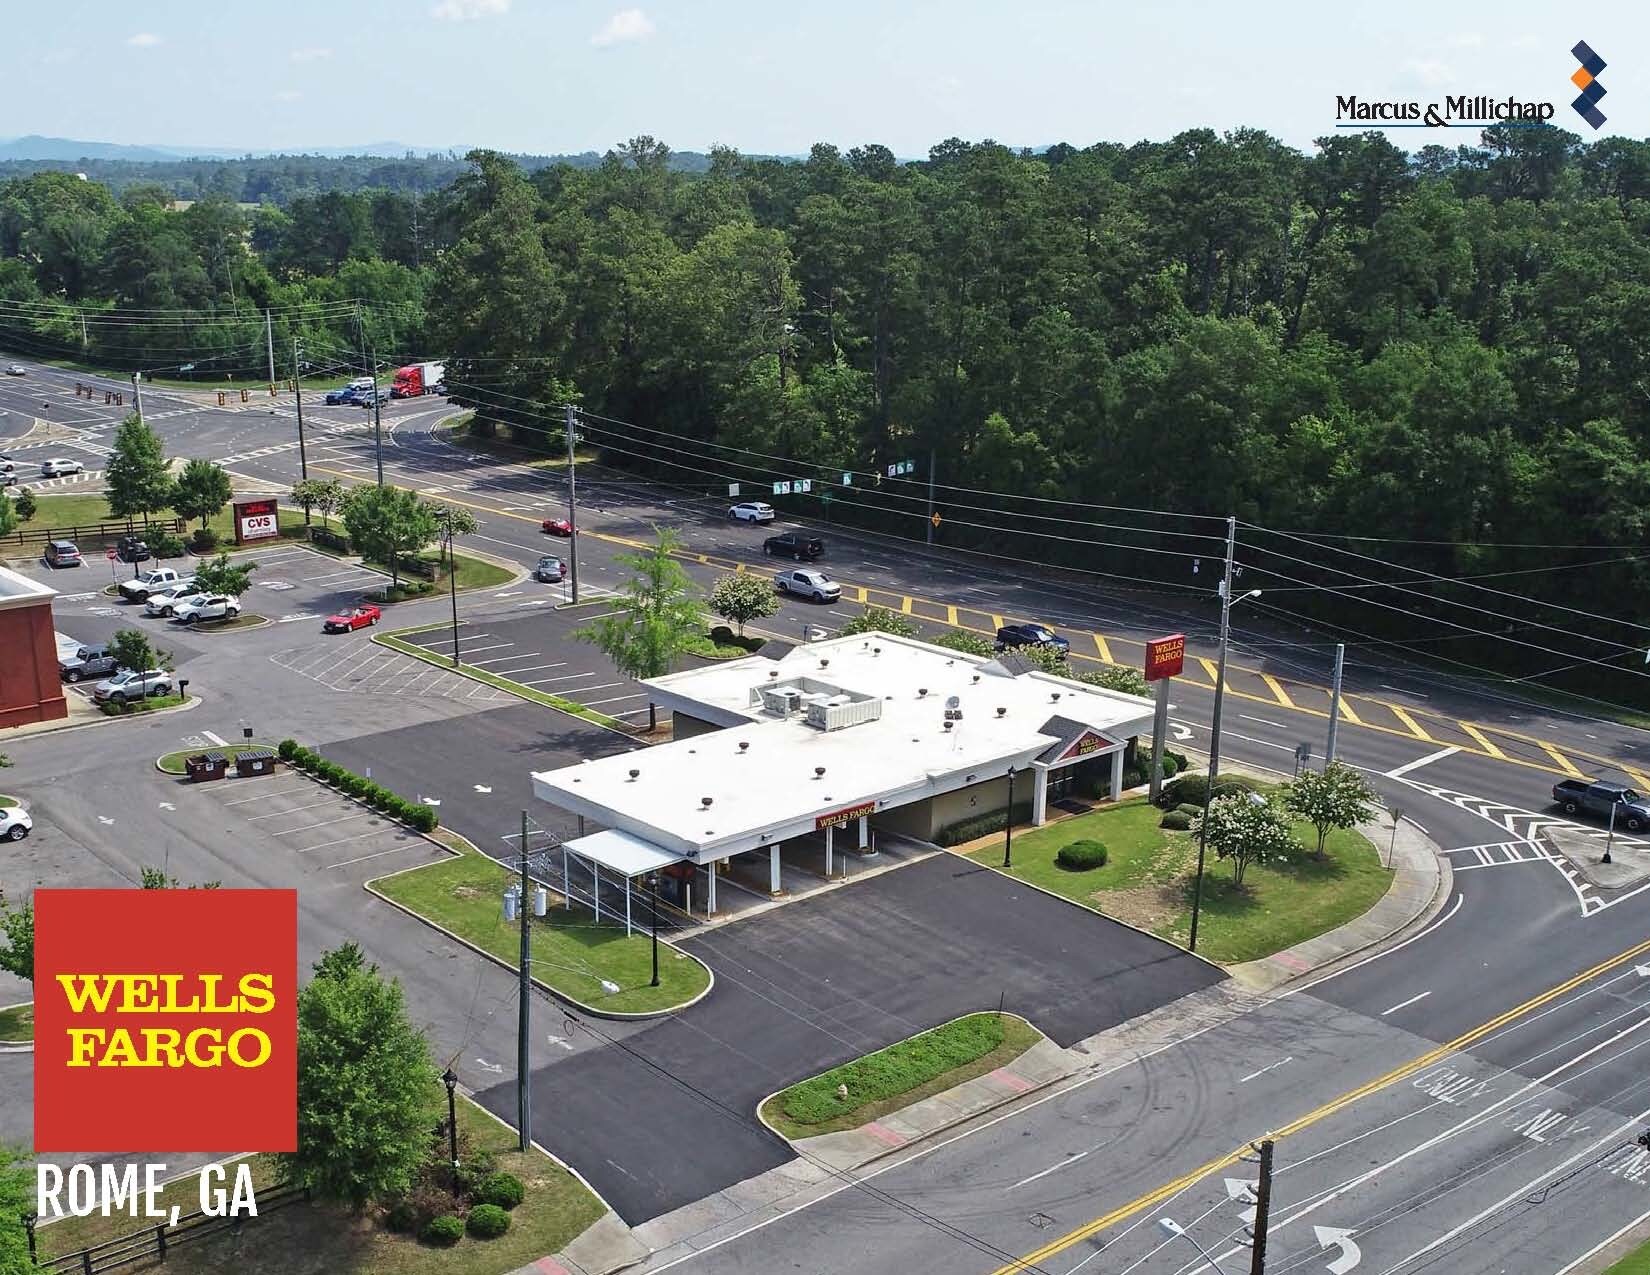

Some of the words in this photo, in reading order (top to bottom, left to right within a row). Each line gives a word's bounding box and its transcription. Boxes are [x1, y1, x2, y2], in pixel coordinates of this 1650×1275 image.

[248, 517, 271, 528] CVS
[1155, 639, 1184, 653] WELLS
[1155, 650, 1183, 664] FARGO
[819, 813, 849, 828] WELLS
[849, 805, 877, 820] FARGO
